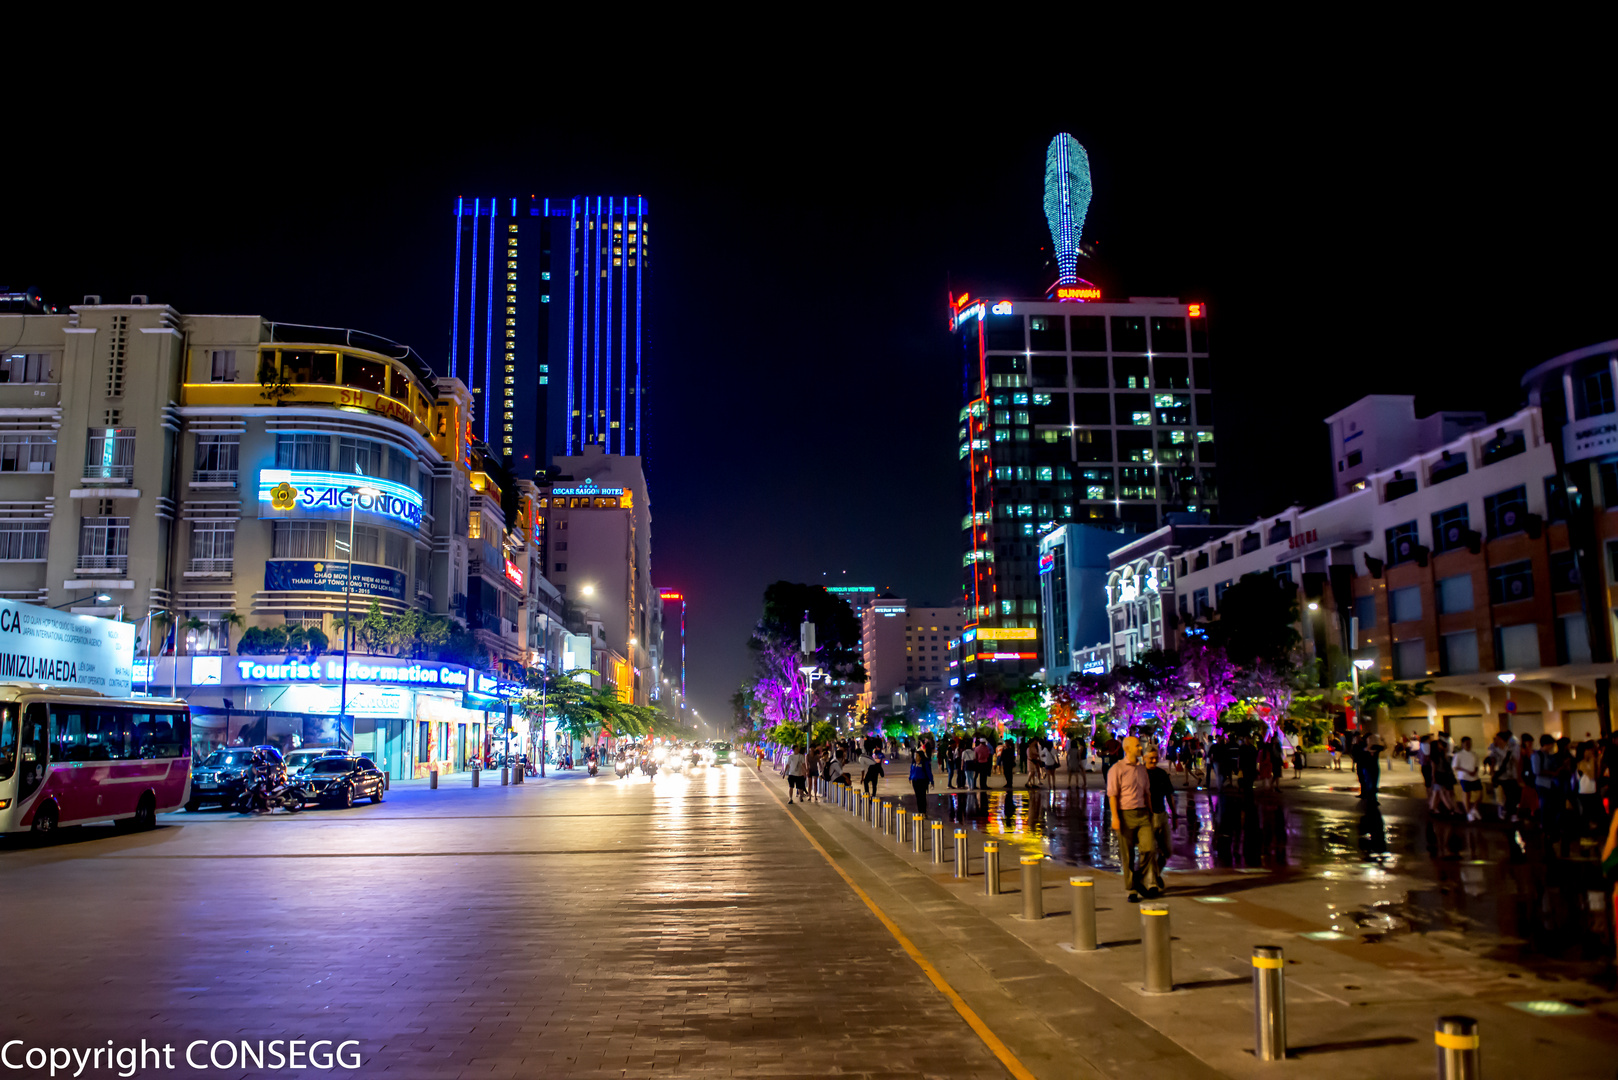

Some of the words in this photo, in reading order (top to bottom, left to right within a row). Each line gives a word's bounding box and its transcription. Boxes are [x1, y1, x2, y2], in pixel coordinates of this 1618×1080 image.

[1058, 289, 1100, 298] SUNWAH
[340, 390, 362, 404] SH
[238, 660, 321, 679] Tourist
[326, 662, 438, 682] Information
